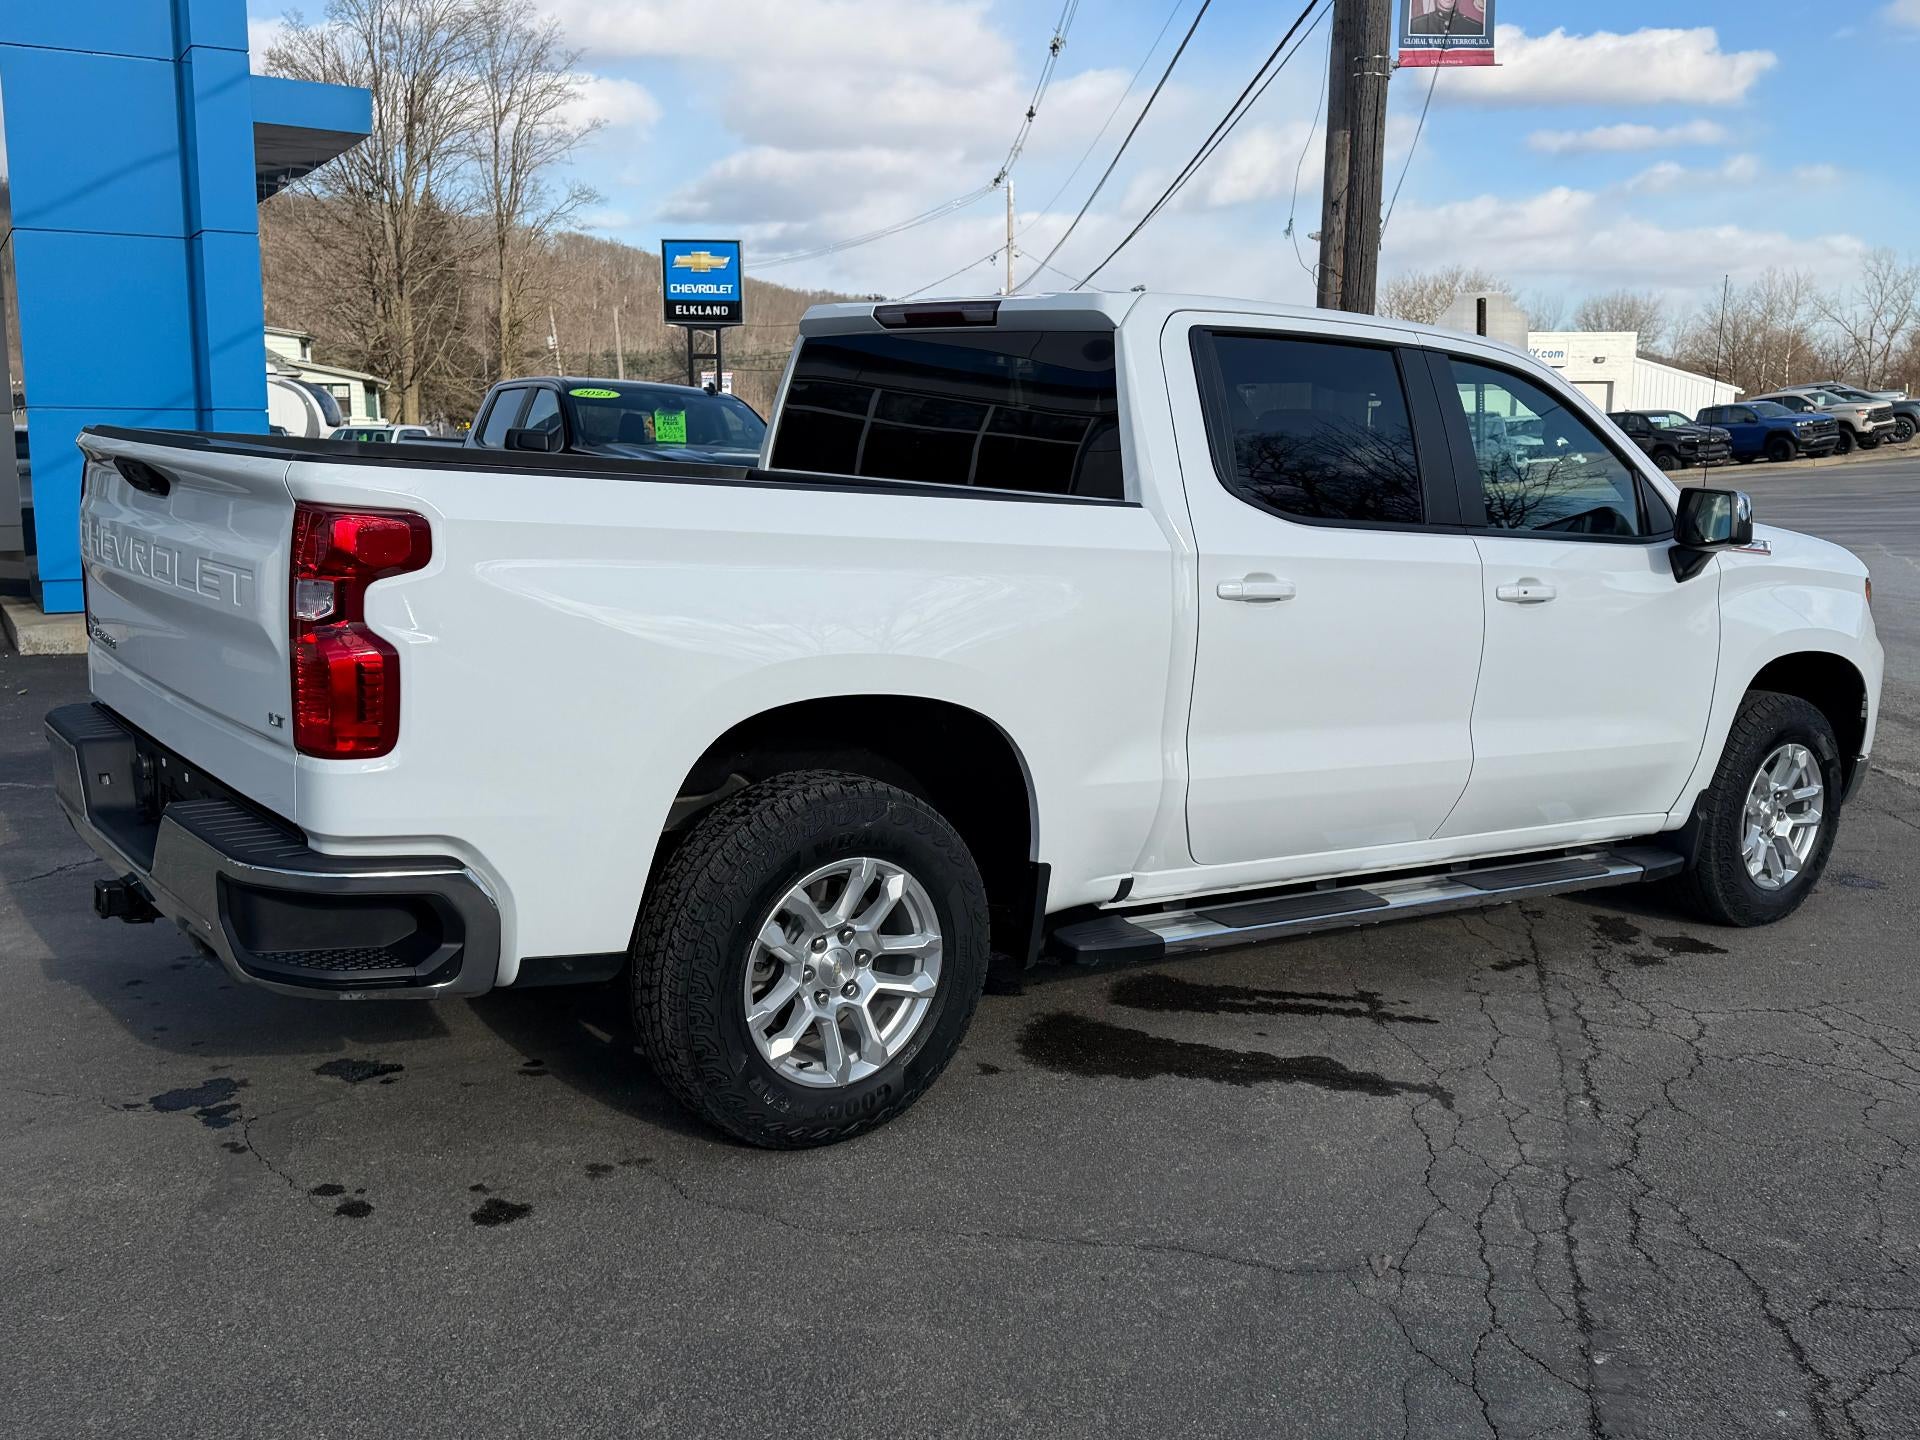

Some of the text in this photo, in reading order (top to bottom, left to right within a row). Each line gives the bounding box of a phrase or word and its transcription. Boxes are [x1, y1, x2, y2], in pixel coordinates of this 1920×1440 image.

[670, 284, 733, 294] CHEVROLET
[675, 305, 729, 315] ELKLAND
[1528, 348, 1564, 358] Y.com
[80, 519, 253, 607] CHEVROLET
[268, 711, 285, 728] LT
